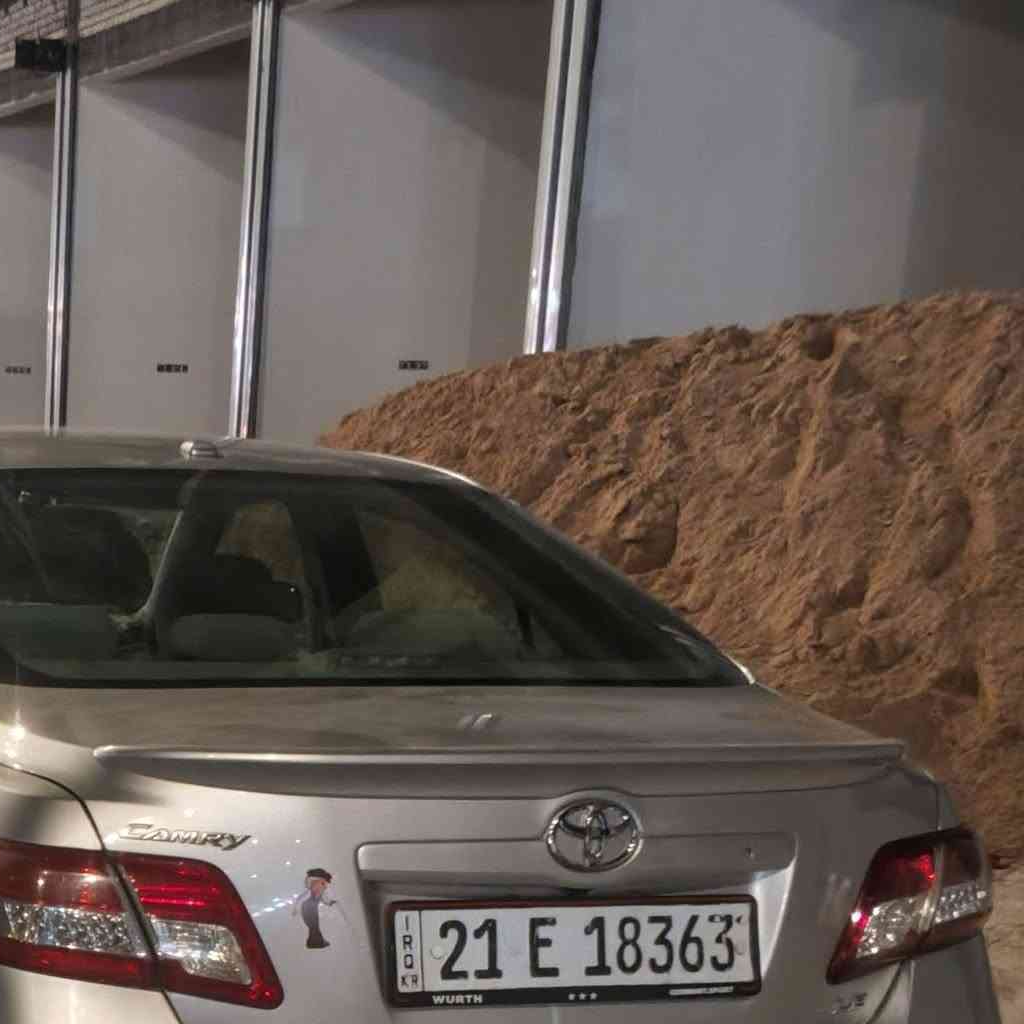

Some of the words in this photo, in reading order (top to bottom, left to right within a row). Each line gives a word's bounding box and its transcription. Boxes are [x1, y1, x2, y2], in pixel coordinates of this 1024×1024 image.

[120, 823, 251, 851] CAMRY
[439, 919, 503, 980] 21
[529, 917, 560, 978] E
[584, 913, 736, 976] 18363
